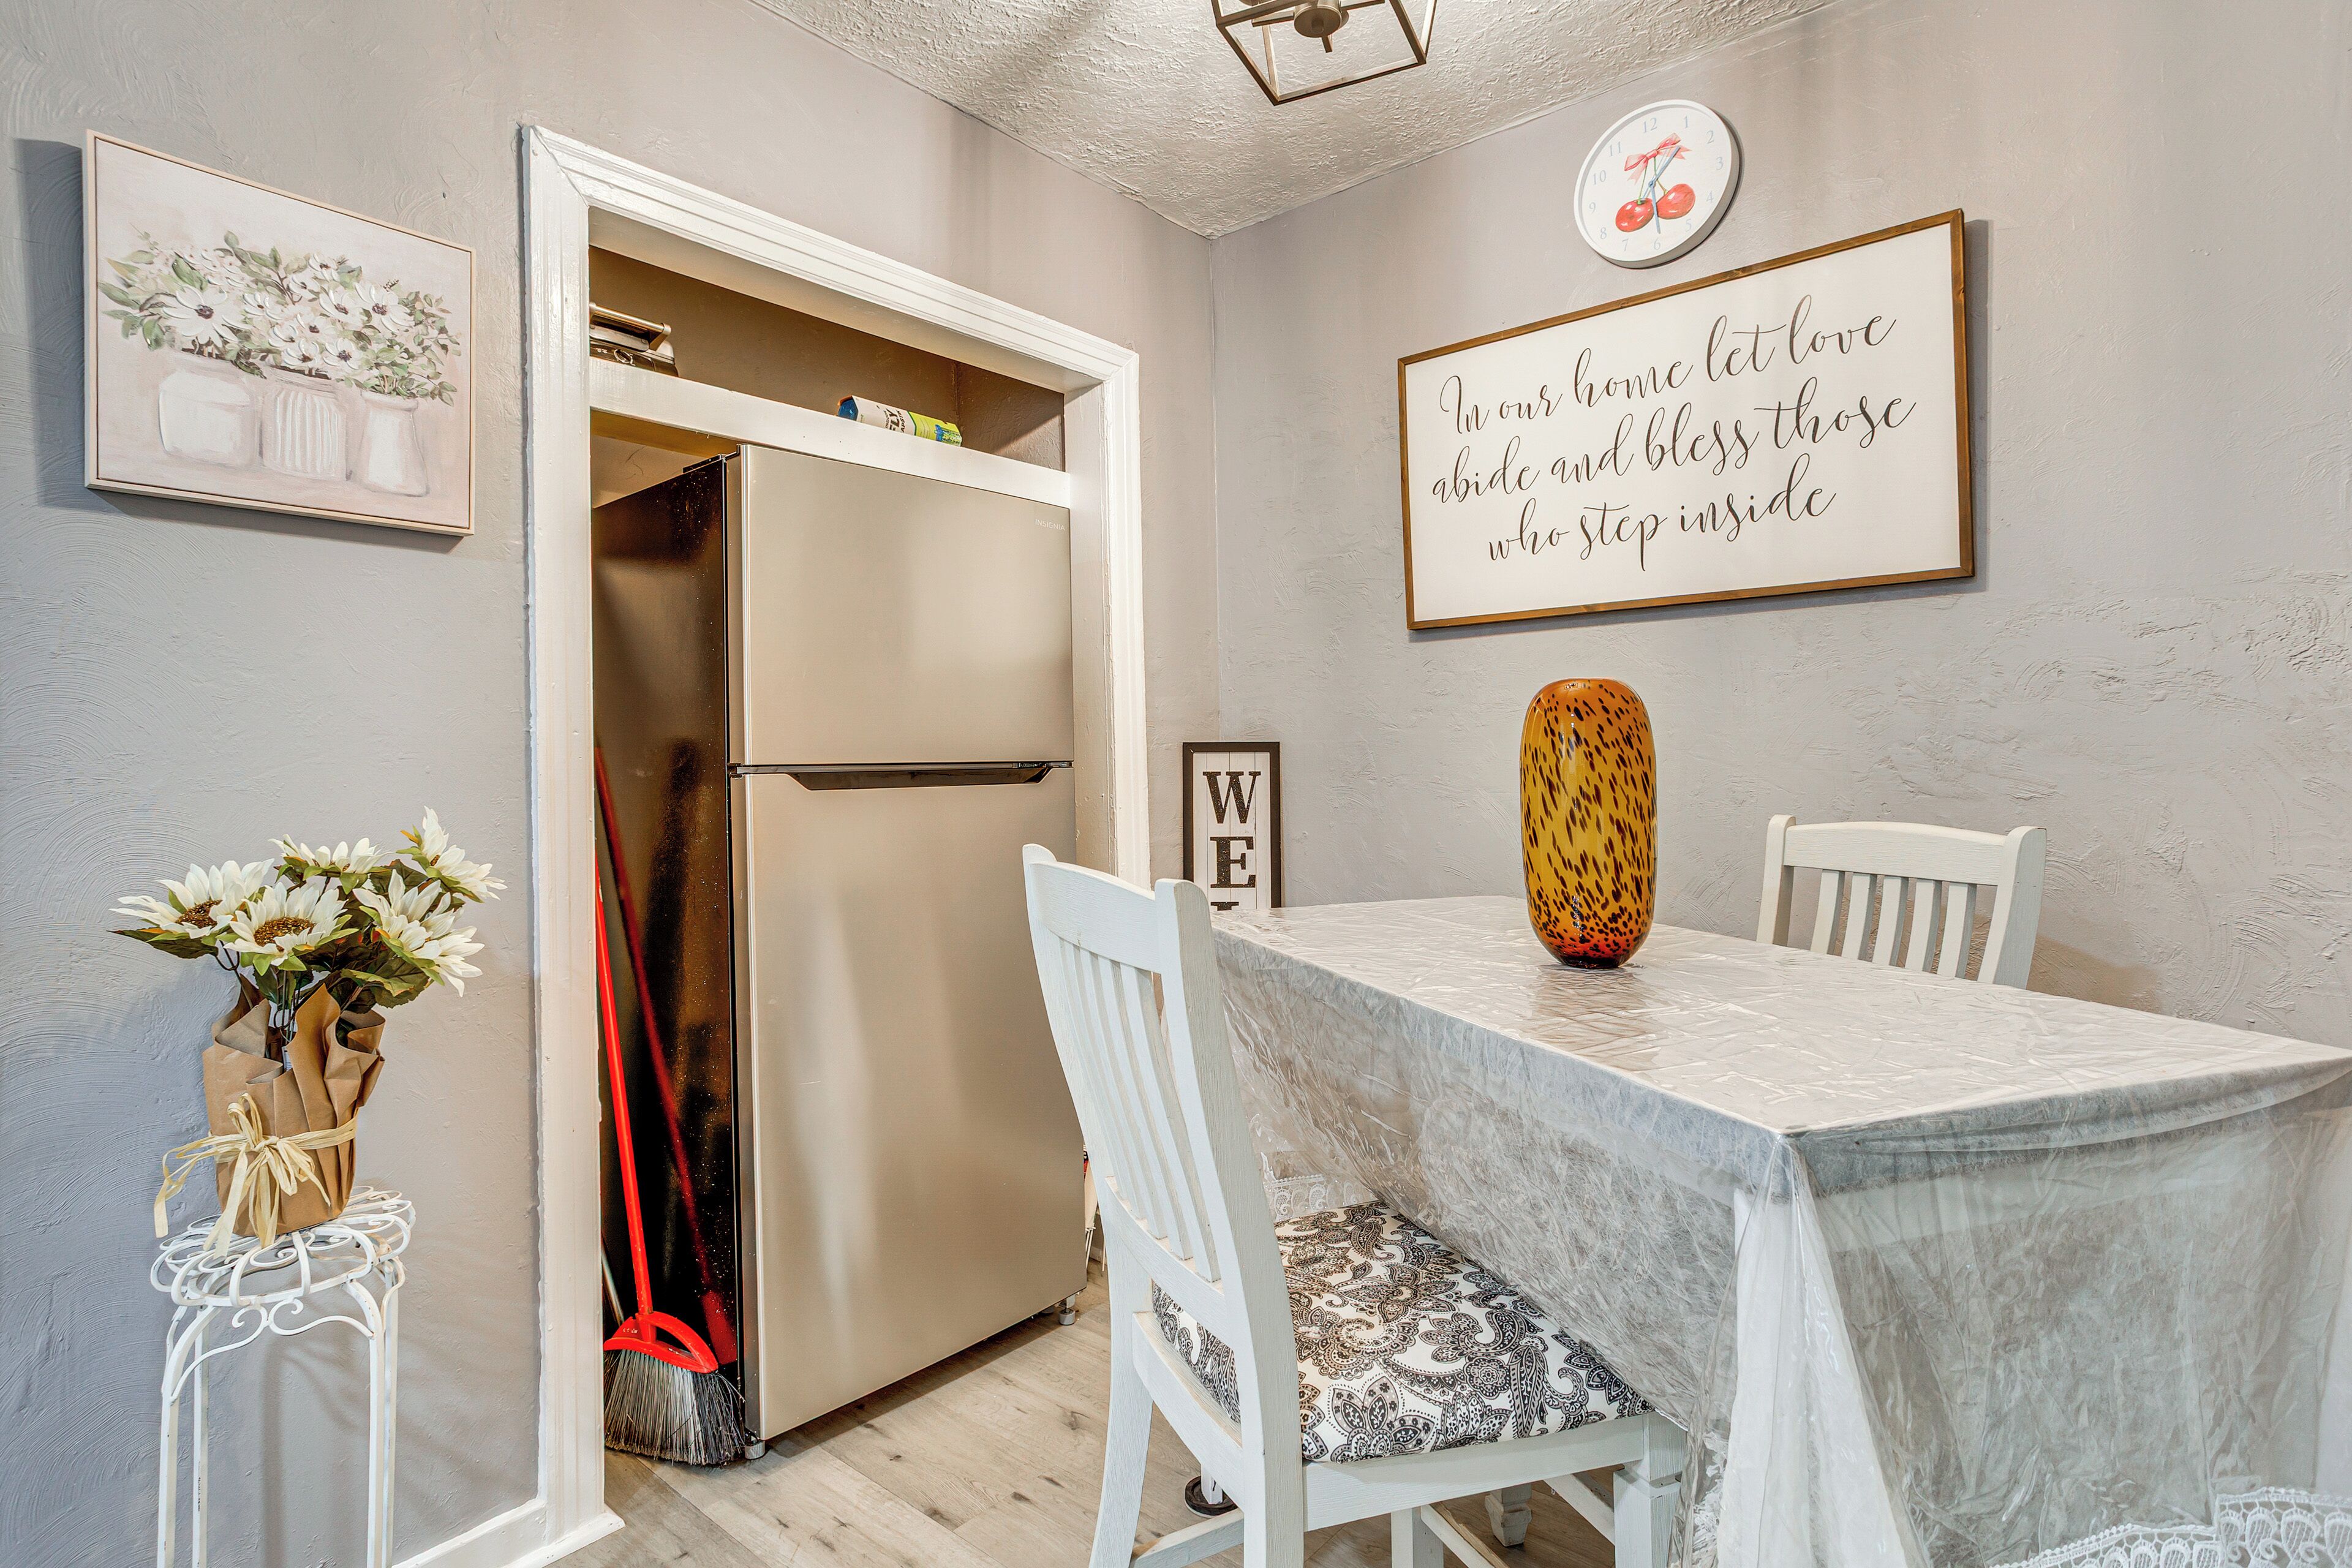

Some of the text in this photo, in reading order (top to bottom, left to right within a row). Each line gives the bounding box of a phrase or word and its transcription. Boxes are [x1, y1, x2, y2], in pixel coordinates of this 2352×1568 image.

[1642, 116, 1658, 134] 12
[1683, 115, 1690, 129] 1
[1706, 129, 1714, 145] 2
[1608, 140, 1621, 157] 11
[1716, 156, 1724, 171] 3
[1593, 169, 1607, 185] 10
[1706, 190, 1714, 204] 4
[1588, 201, 1597, 214] 9
[1684, 218, 1692, 232] 5
[1599, 227, 1608, 240] 8
[1621, 238, 1629, 252] 7
[1653, 236, 1662, 251] 6
[1439, 294, 1897, 434] In our home let love
[1432, 376, 1917, 503] abide and bless those
[1488, 453, 1837, 572] who step inside
[1035, 519, 1065, 530] INSIGNIA
